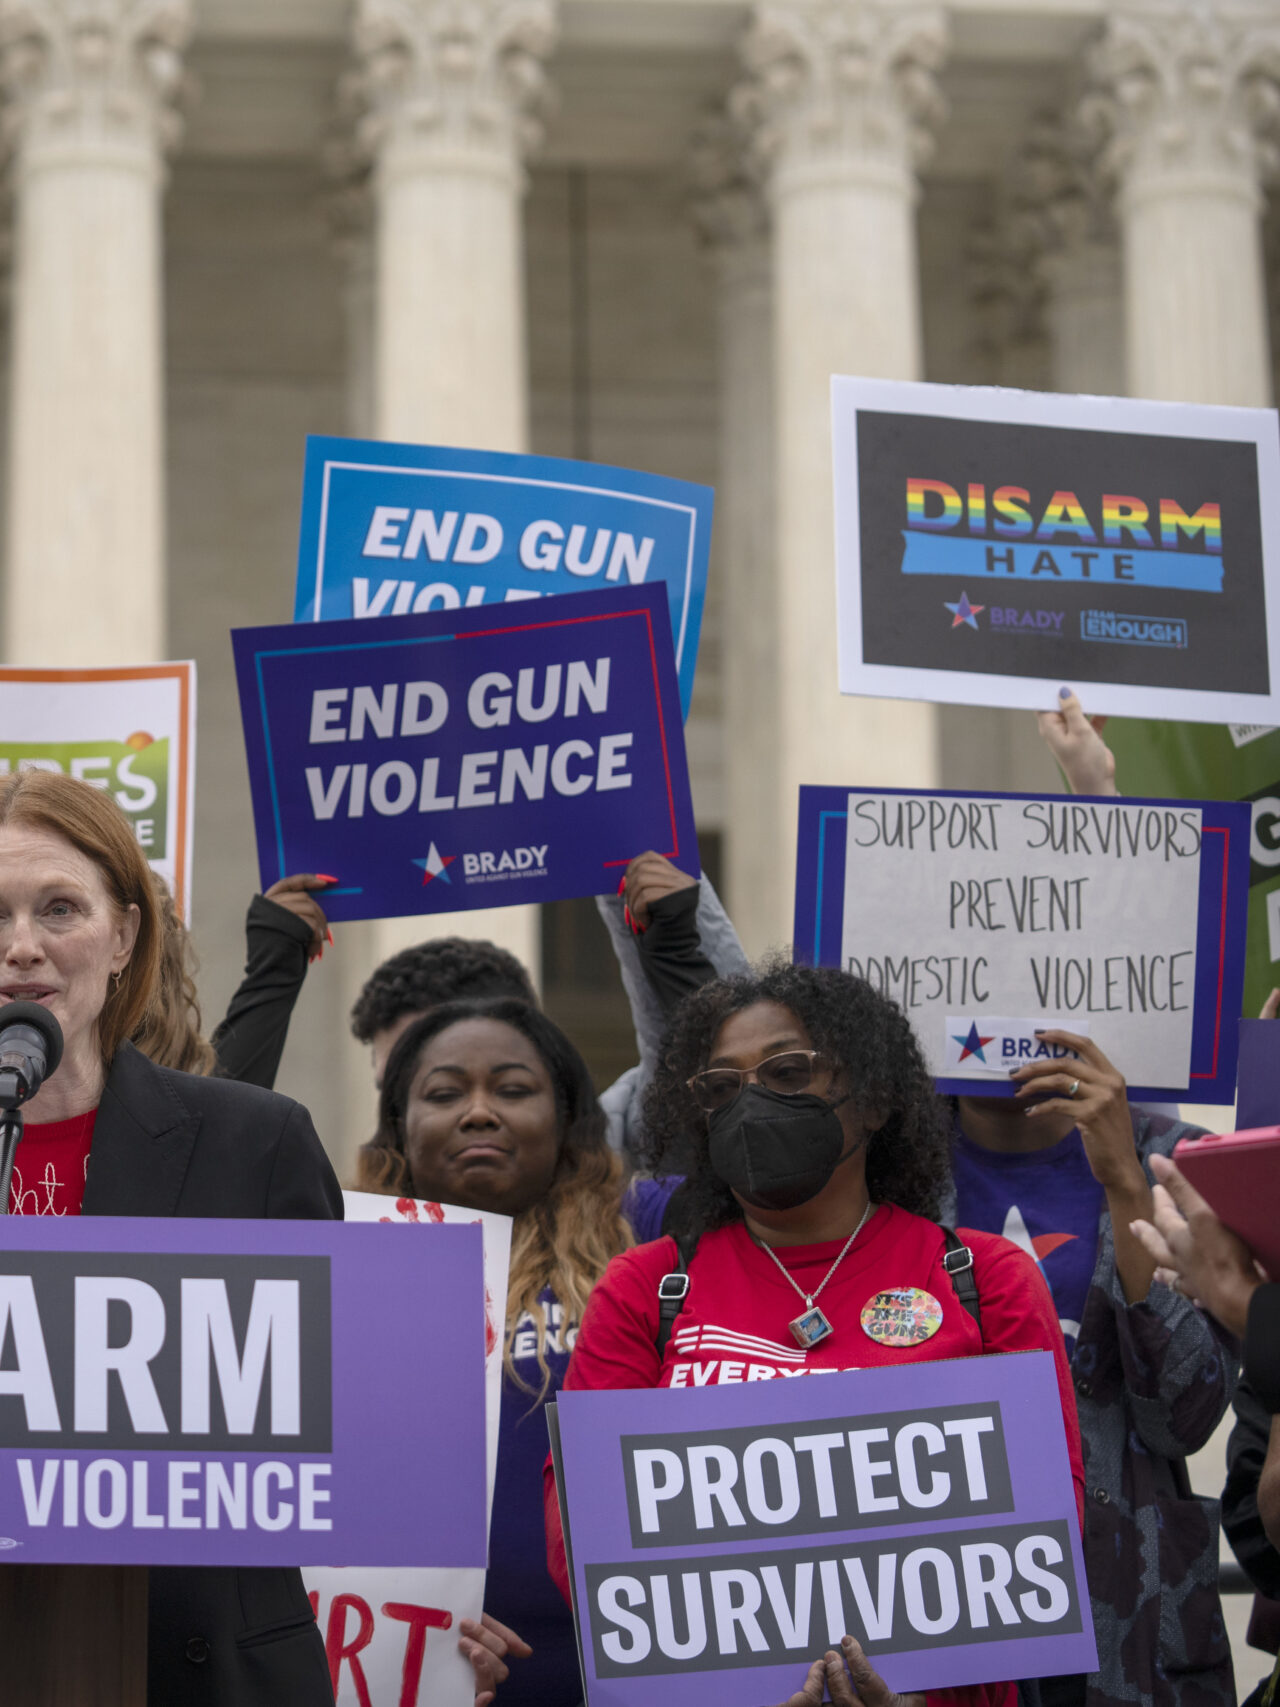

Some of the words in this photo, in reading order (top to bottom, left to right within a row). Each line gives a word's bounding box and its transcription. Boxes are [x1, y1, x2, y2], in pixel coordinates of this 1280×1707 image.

[362, 505, 504, 564] END
[519, 519, 655, 586] GUN
[907, 477, 1222, 554] DISARM
[985, 546, 1135, 580] HATE
[990, 606, 1065, 630] BRADY
[1087, 618, 1182, 642] ENOUGH
[1088, 609, 1116, 620] TEAM
[308, 680, 449, 744] END
[467, 657, 611, 730] GUN
[305, 733, 633, 821] VIOLENCE
[463, 845, 548, 875] BRADY
[854, 799, 1002, 852] SUPPORT
[1022, 803, 1203, 862] SURVIVORS
[949, 875, 1090, 932] PREVENT
[1030, 951, 1194, 1013] VIOLENCE
[868, 1322, 929, 1340] GUNS
[872, 1307, 914, 1322] THE
[17, 1458, 333, 1532] VIOLENCE
[633, 1416, 996, 1533] PROTECT
[597, 1534, 1071, 1664] SURVIVORS
